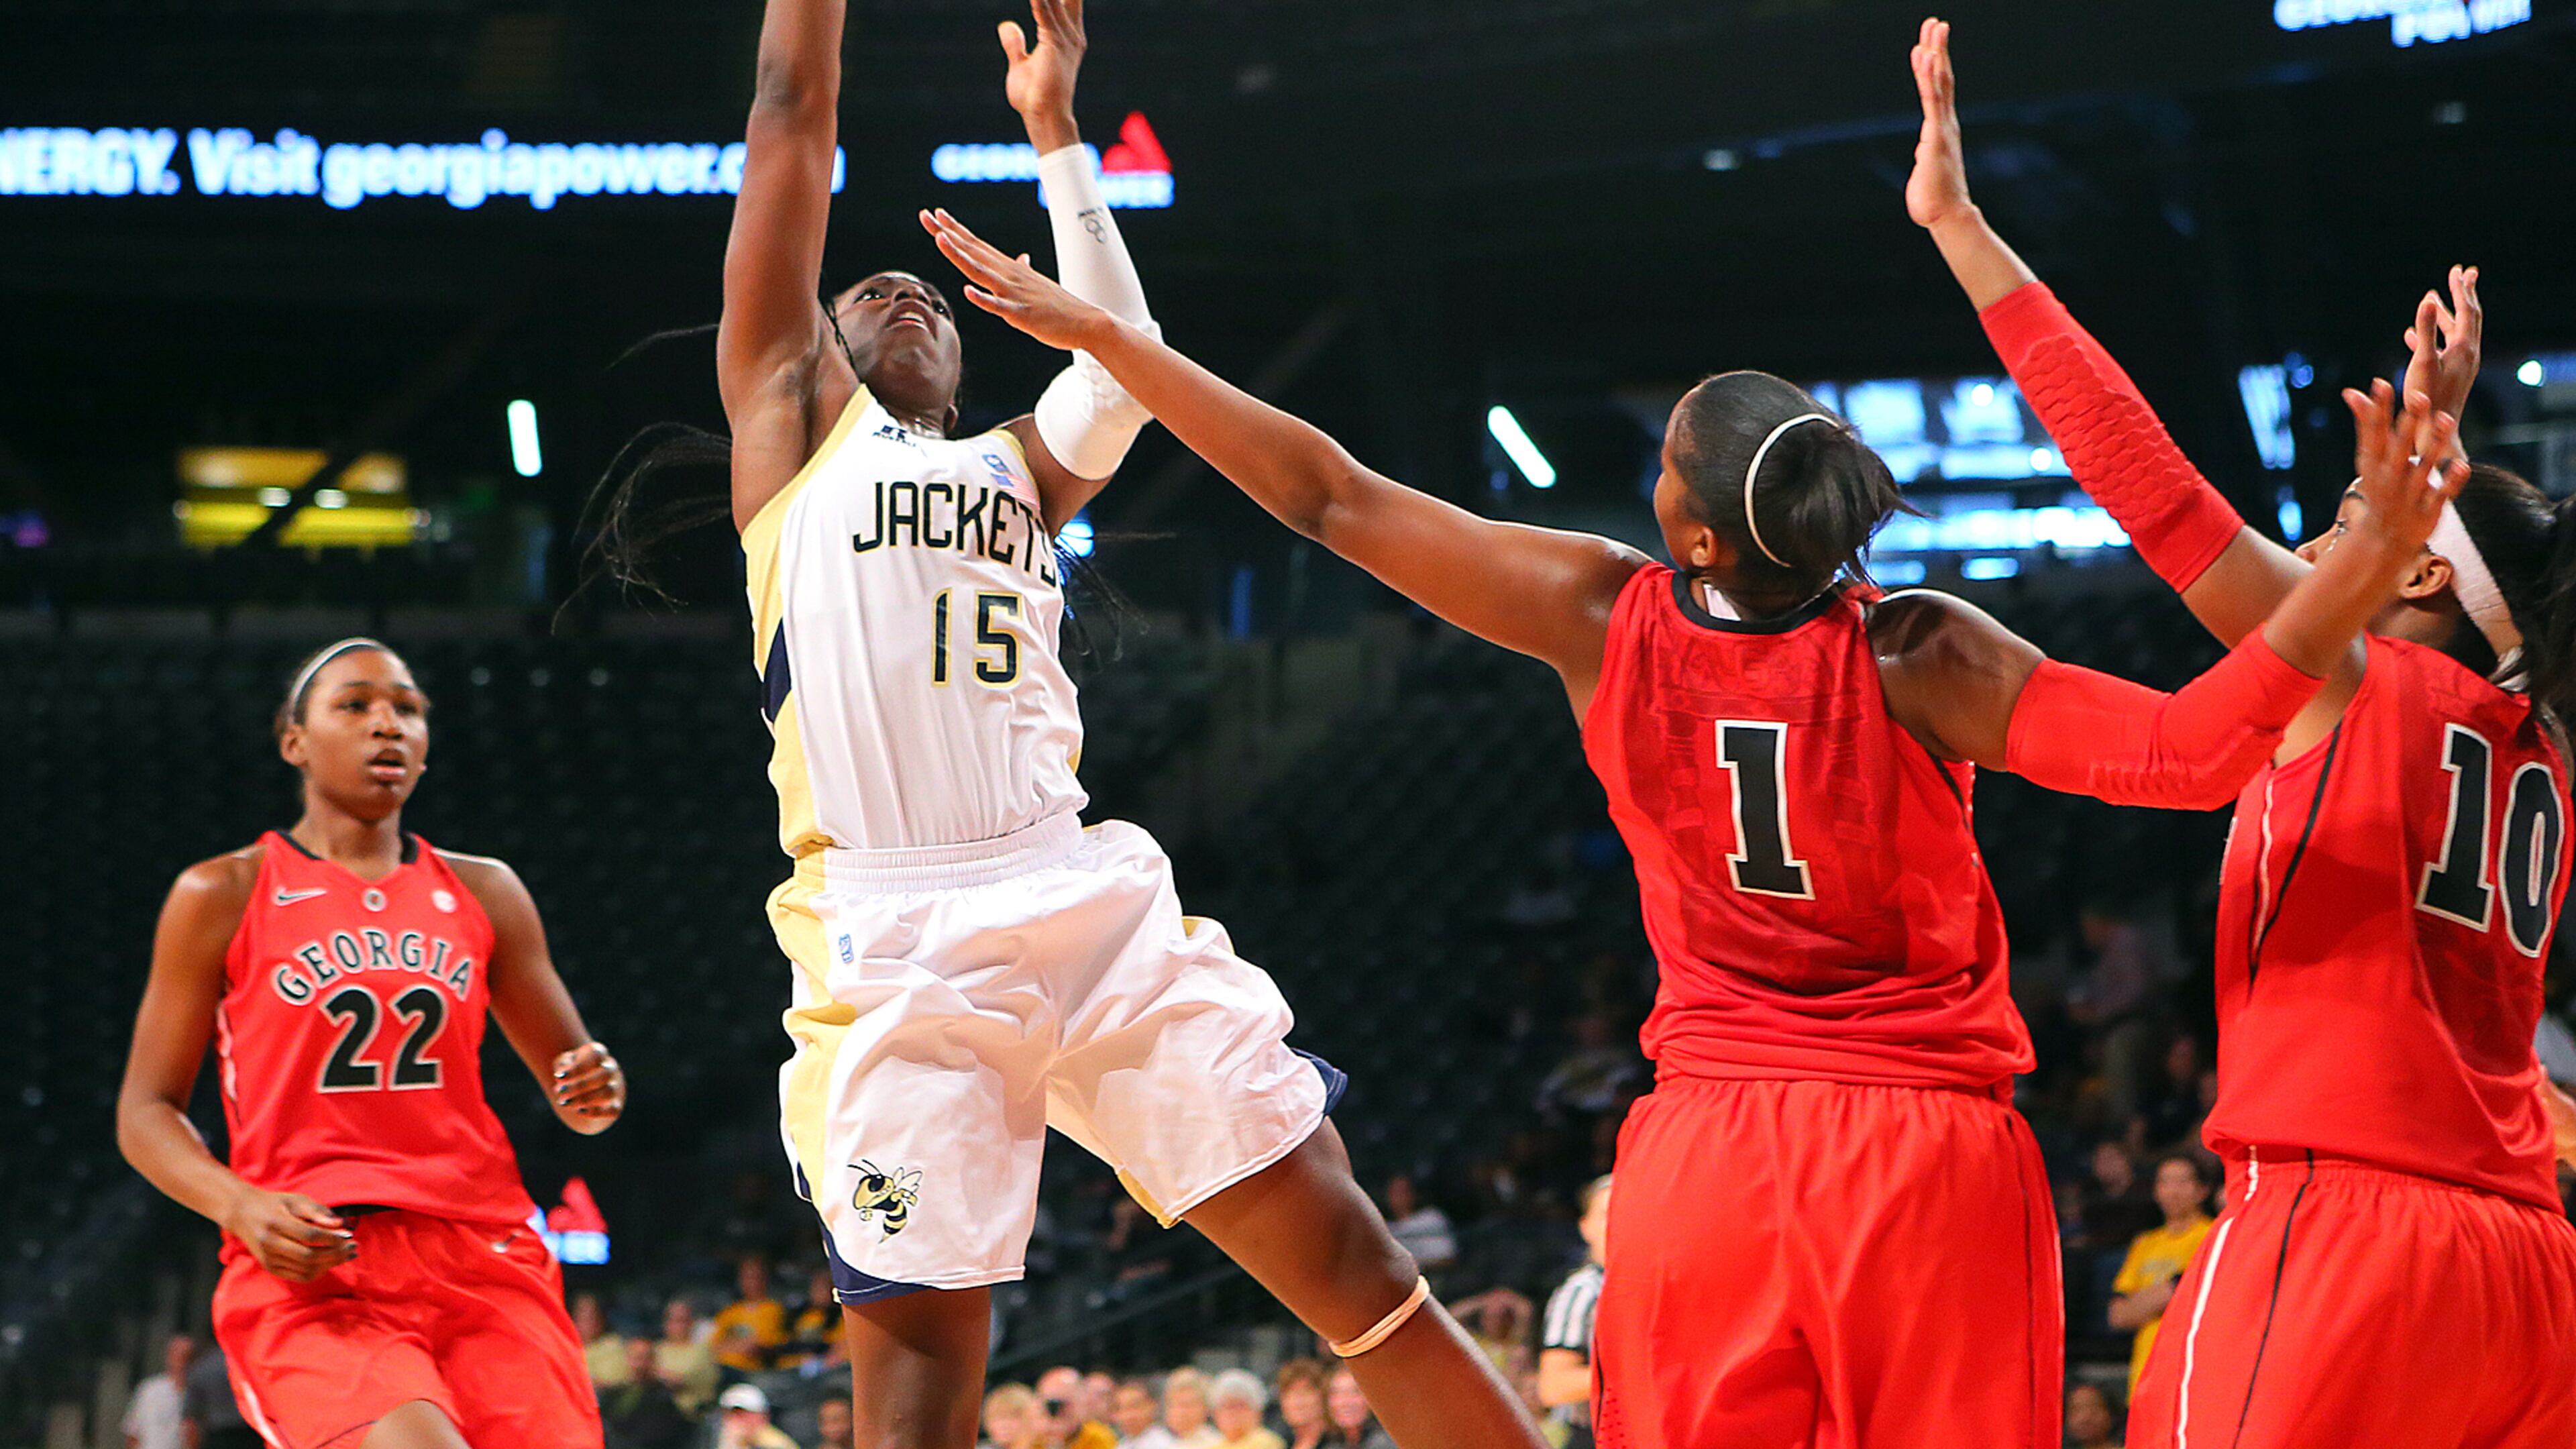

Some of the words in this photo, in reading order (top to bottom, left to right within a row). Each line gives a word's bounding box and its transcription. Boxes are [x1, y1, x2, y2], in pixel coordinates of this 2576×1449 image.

[187, 127, 321, 195] Visit
[322, 127, 845, 210] georgiapower.c
[930, 586, 1024, 690] 15
[1715, 719, 1816, 900] 1
[2415, 722, 2565, 958] 10
[272, 928, 480, 1006] GEORGIA
[318, 983, 447, 1094] 22
